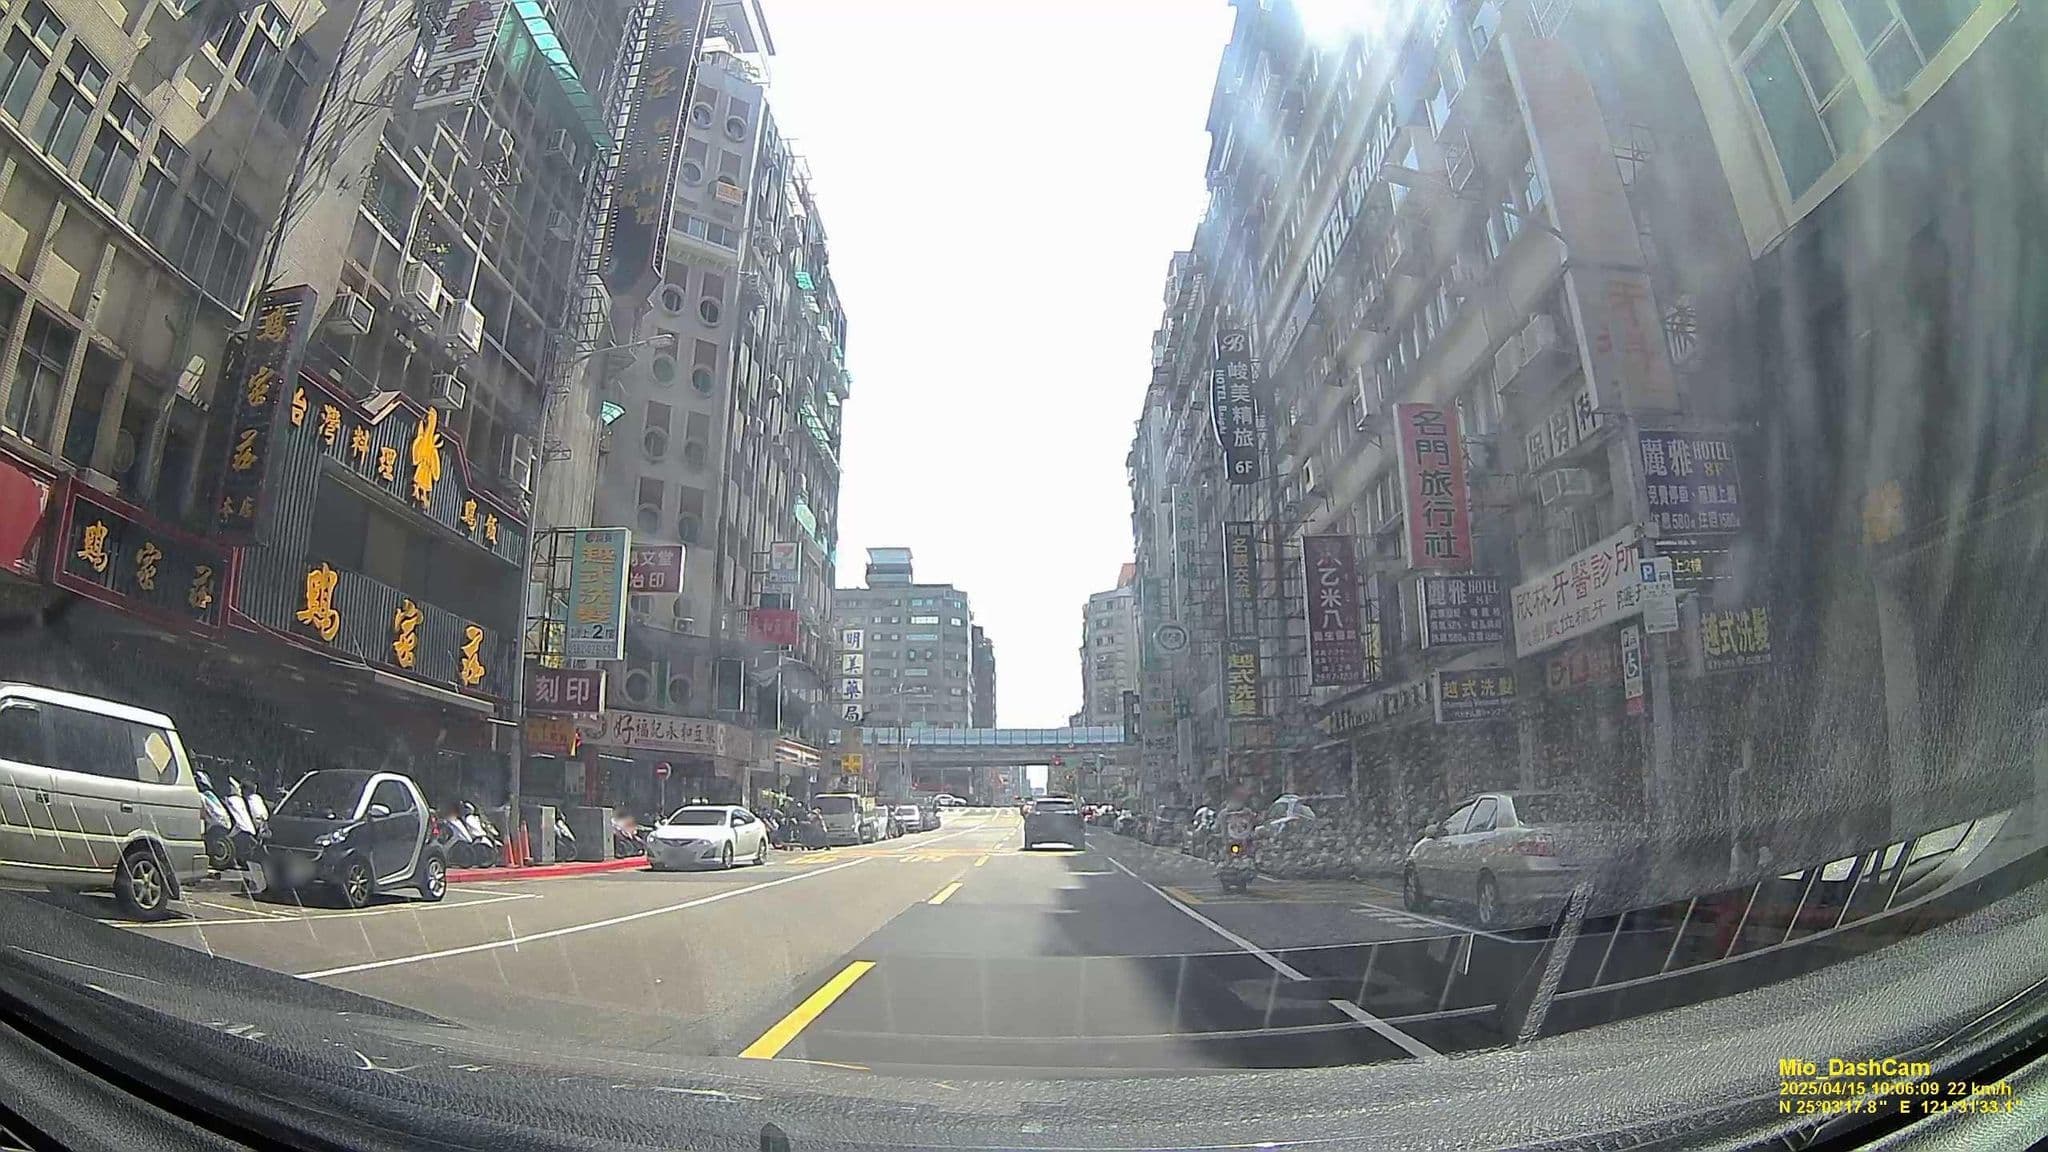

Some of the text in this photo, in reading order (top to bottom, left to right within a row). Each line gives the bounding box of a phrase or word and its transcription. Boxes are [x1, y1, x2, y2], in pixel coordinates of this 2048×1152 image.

[1306, 102, 1398, 305] HOTEL Bright
[1215, 369, 1227, 401] HOTEL
[1227, 361, 1254, 448] 峻美精旅
[291, 386, 398, 482] 台灣料理
[1640, 439, 1731, 477] 麗雅 HOTEL
[1234, 460, 1254, 474] 6F
[1412, 410, 1460, 559] 名門旅行社
[1467, 579, 1499, 594] HOTEL
[534, 674, 591, 706] 刻印
[843, 631, 862, 722] 明美藥局
